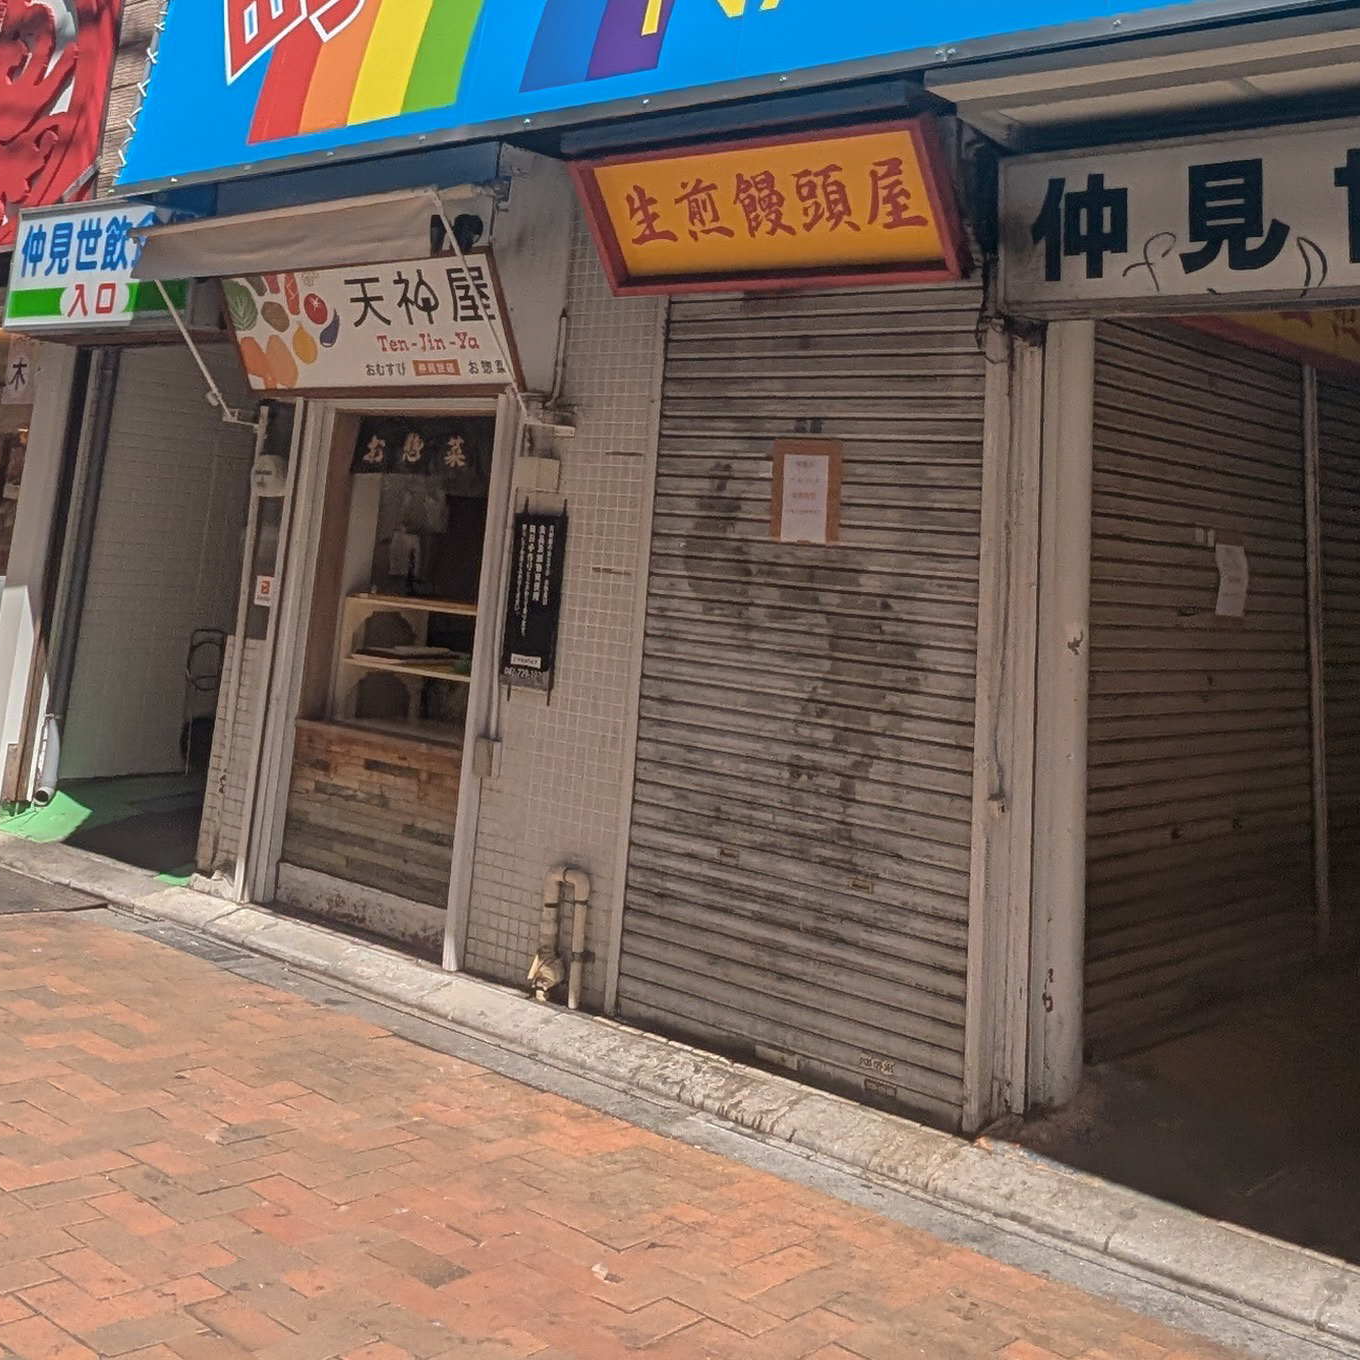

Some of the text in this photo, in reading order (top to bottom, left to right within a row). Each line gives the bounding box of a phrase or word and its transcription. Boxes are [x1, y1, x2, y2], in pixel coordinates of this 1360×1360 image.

[625, 156, 929, 246] 生煎饅頭屋
[67, 282, 117, 318] 入口
[343, 264, 497, 329] 天神屋
